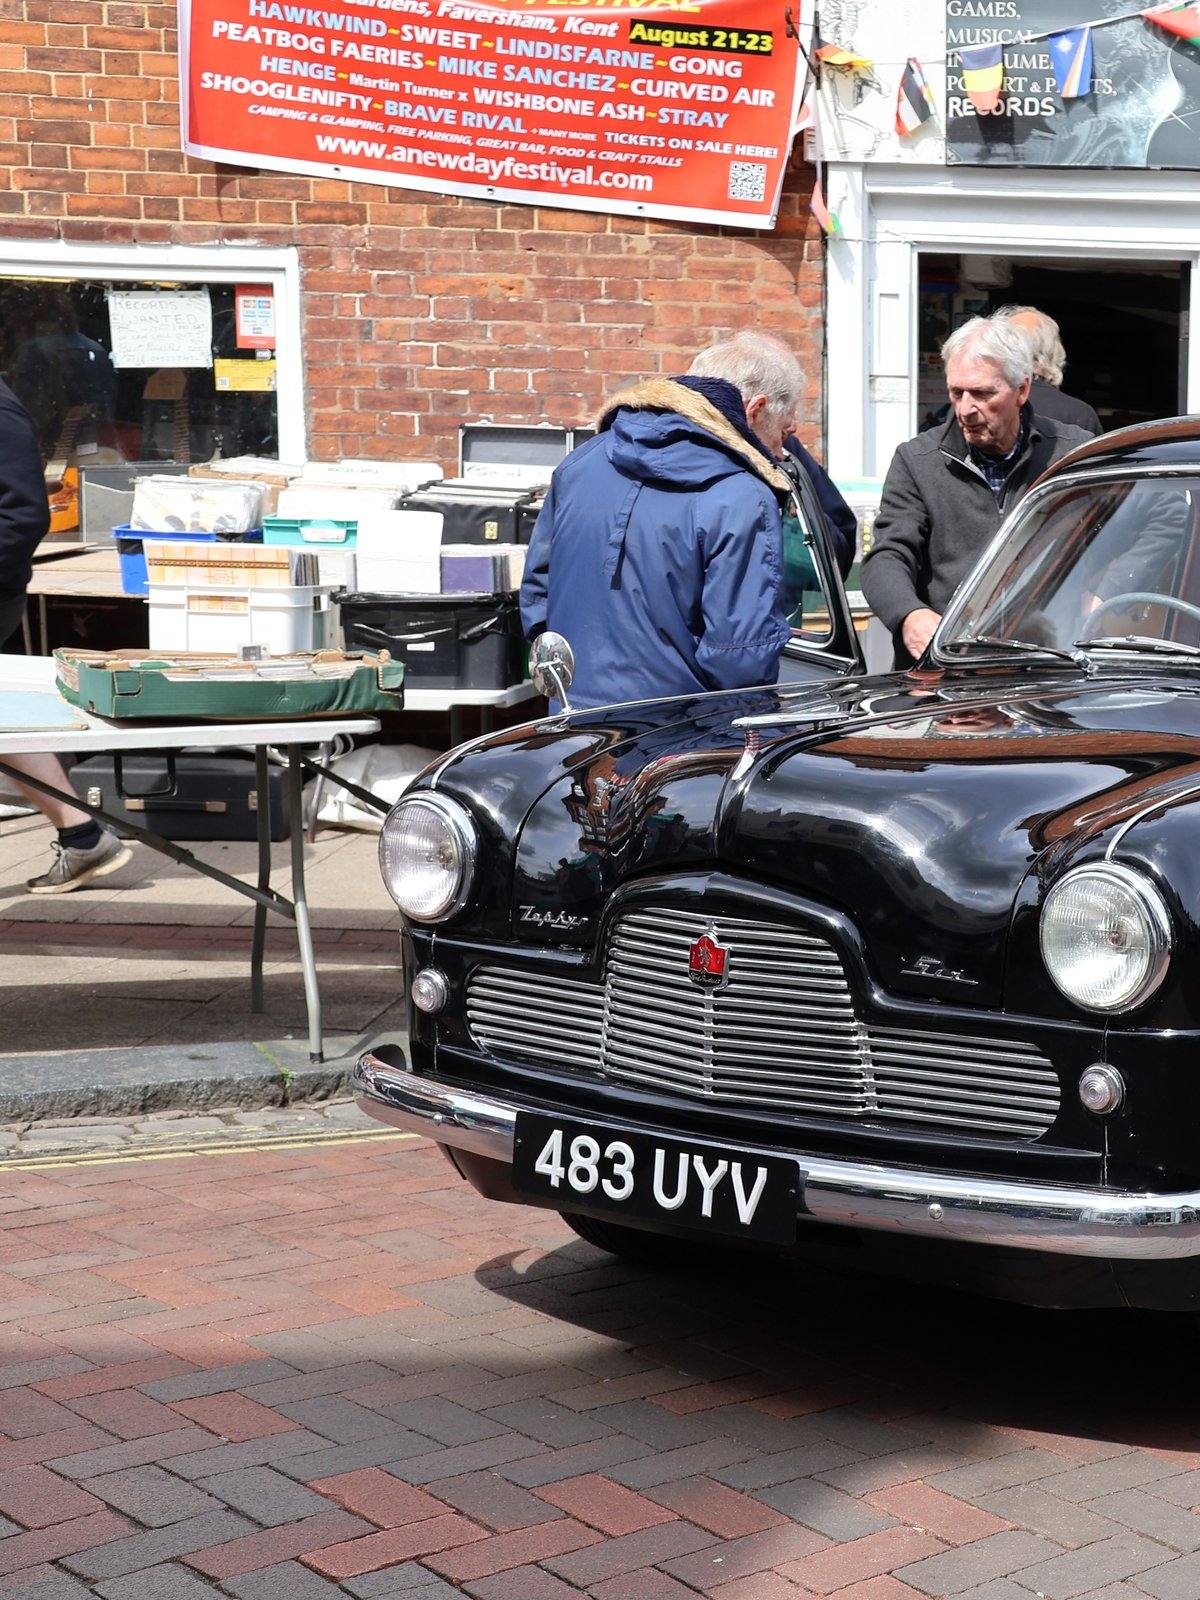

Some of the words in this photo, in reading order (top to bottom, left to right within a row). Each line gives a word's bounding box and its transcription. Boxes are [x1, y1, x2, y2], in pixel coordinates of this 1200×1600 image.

[341, 0, 433, 17] ardens,
[436, 3, 559, 33] Faversham,
[562, 16, 619, 38] Kent
[629, 22, 709, 48] August
[711, 31, 773, 52] 21-23
[947, 1, 1021, 19] GAMES,
[947, 28, 1037, 45] MUSICAL
[212, 20, 326, 54] PEATBOG
[330, 39, 424, 70] FAERIES
[437, 55, 497, 79] MIKE
[503, 64, 617, 93] SANCHEZ
[630, 78, 728, 104] CURVED
[732, 87, 776, 108] AIR
[249, 1, 388, 37] HAWKWIND
[400, 24, 482, 50] SWEET
[495, 37, 655, 70] LINDISFARNE
[668, 55, 743, 78] GONG
[200, 71, 374, 112] SHOOGLENIFTY
[384, 100, 457, 125] BRAVE
[461, 107, 528, 134] RIVAL
[260, 55, 337, 81] HENGE
[348, 72, 400, 93] Martin
[402, 81, 455, 100] Turner
[473, 87, 595, 117] WISHBONE
[598, 103, 646, 122] ASH
[657, 107, 730, 129] STRAY
[1029, 82, 1041, 92] &
[247, 104, 308, 122] CAMPING
[309, 113, 318, 123] &
[319, 114, 385, 134] GLAMPING,
[387, 124, 418, 137] FREE
[418, 127, 474, 146] PARKING,
[476, 137, 517, 153] GREAT
[518, 141, 546, 156] BAR,
[548, 144, 586, 158] FOOD
[587, 148, 597, 159] &
[598, 149, 638, 164] CRAFT
[638, 153, 684, 168] STALLS
[315, 134, 653, 191] www.anewdayfestival.com
[604, 131, 666, 149] TICKETS
[668, 137, 694, 150] ON
[695, 140, 732, 154] SALE
[734, 143, 778, 159] HERE!
[534, 1128, 636, 1202] 483
[652, 1147, 768, 1225] UYV
